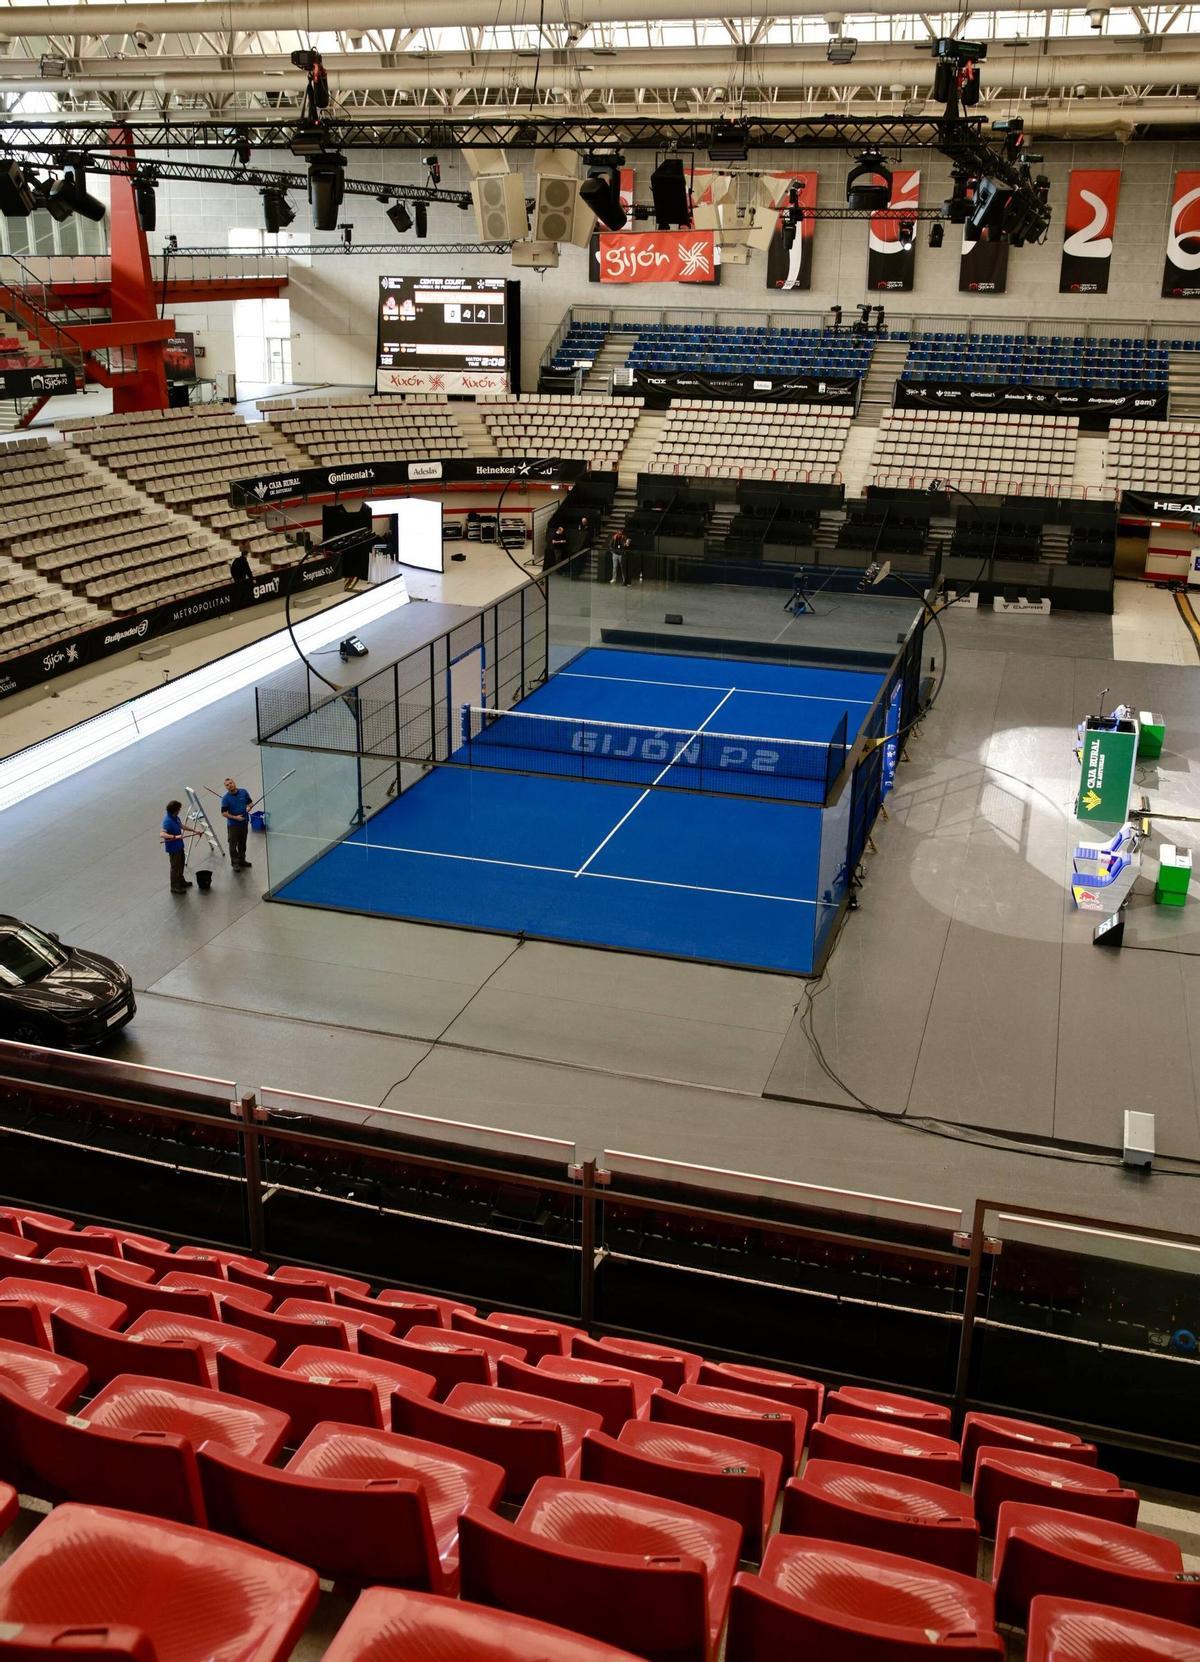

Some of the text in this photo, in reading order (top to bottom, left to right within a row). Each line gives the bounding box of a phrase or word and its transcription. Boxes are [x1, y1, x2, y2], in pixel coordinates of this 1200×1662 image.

[605, 243, 671, 277] gijón
[327, 468, 369, 485] Continental
[413, 467, 438, 476] Adeslas
[476, 465, 516, 475] Heineken
[253, 582, 276, 599] gam
[173, 595, 231, 621] METROPOLITAN
[571, 730, 780, 773] GIJÓN P2
[1086, 739, 1101, 789] CAJA RURAL
